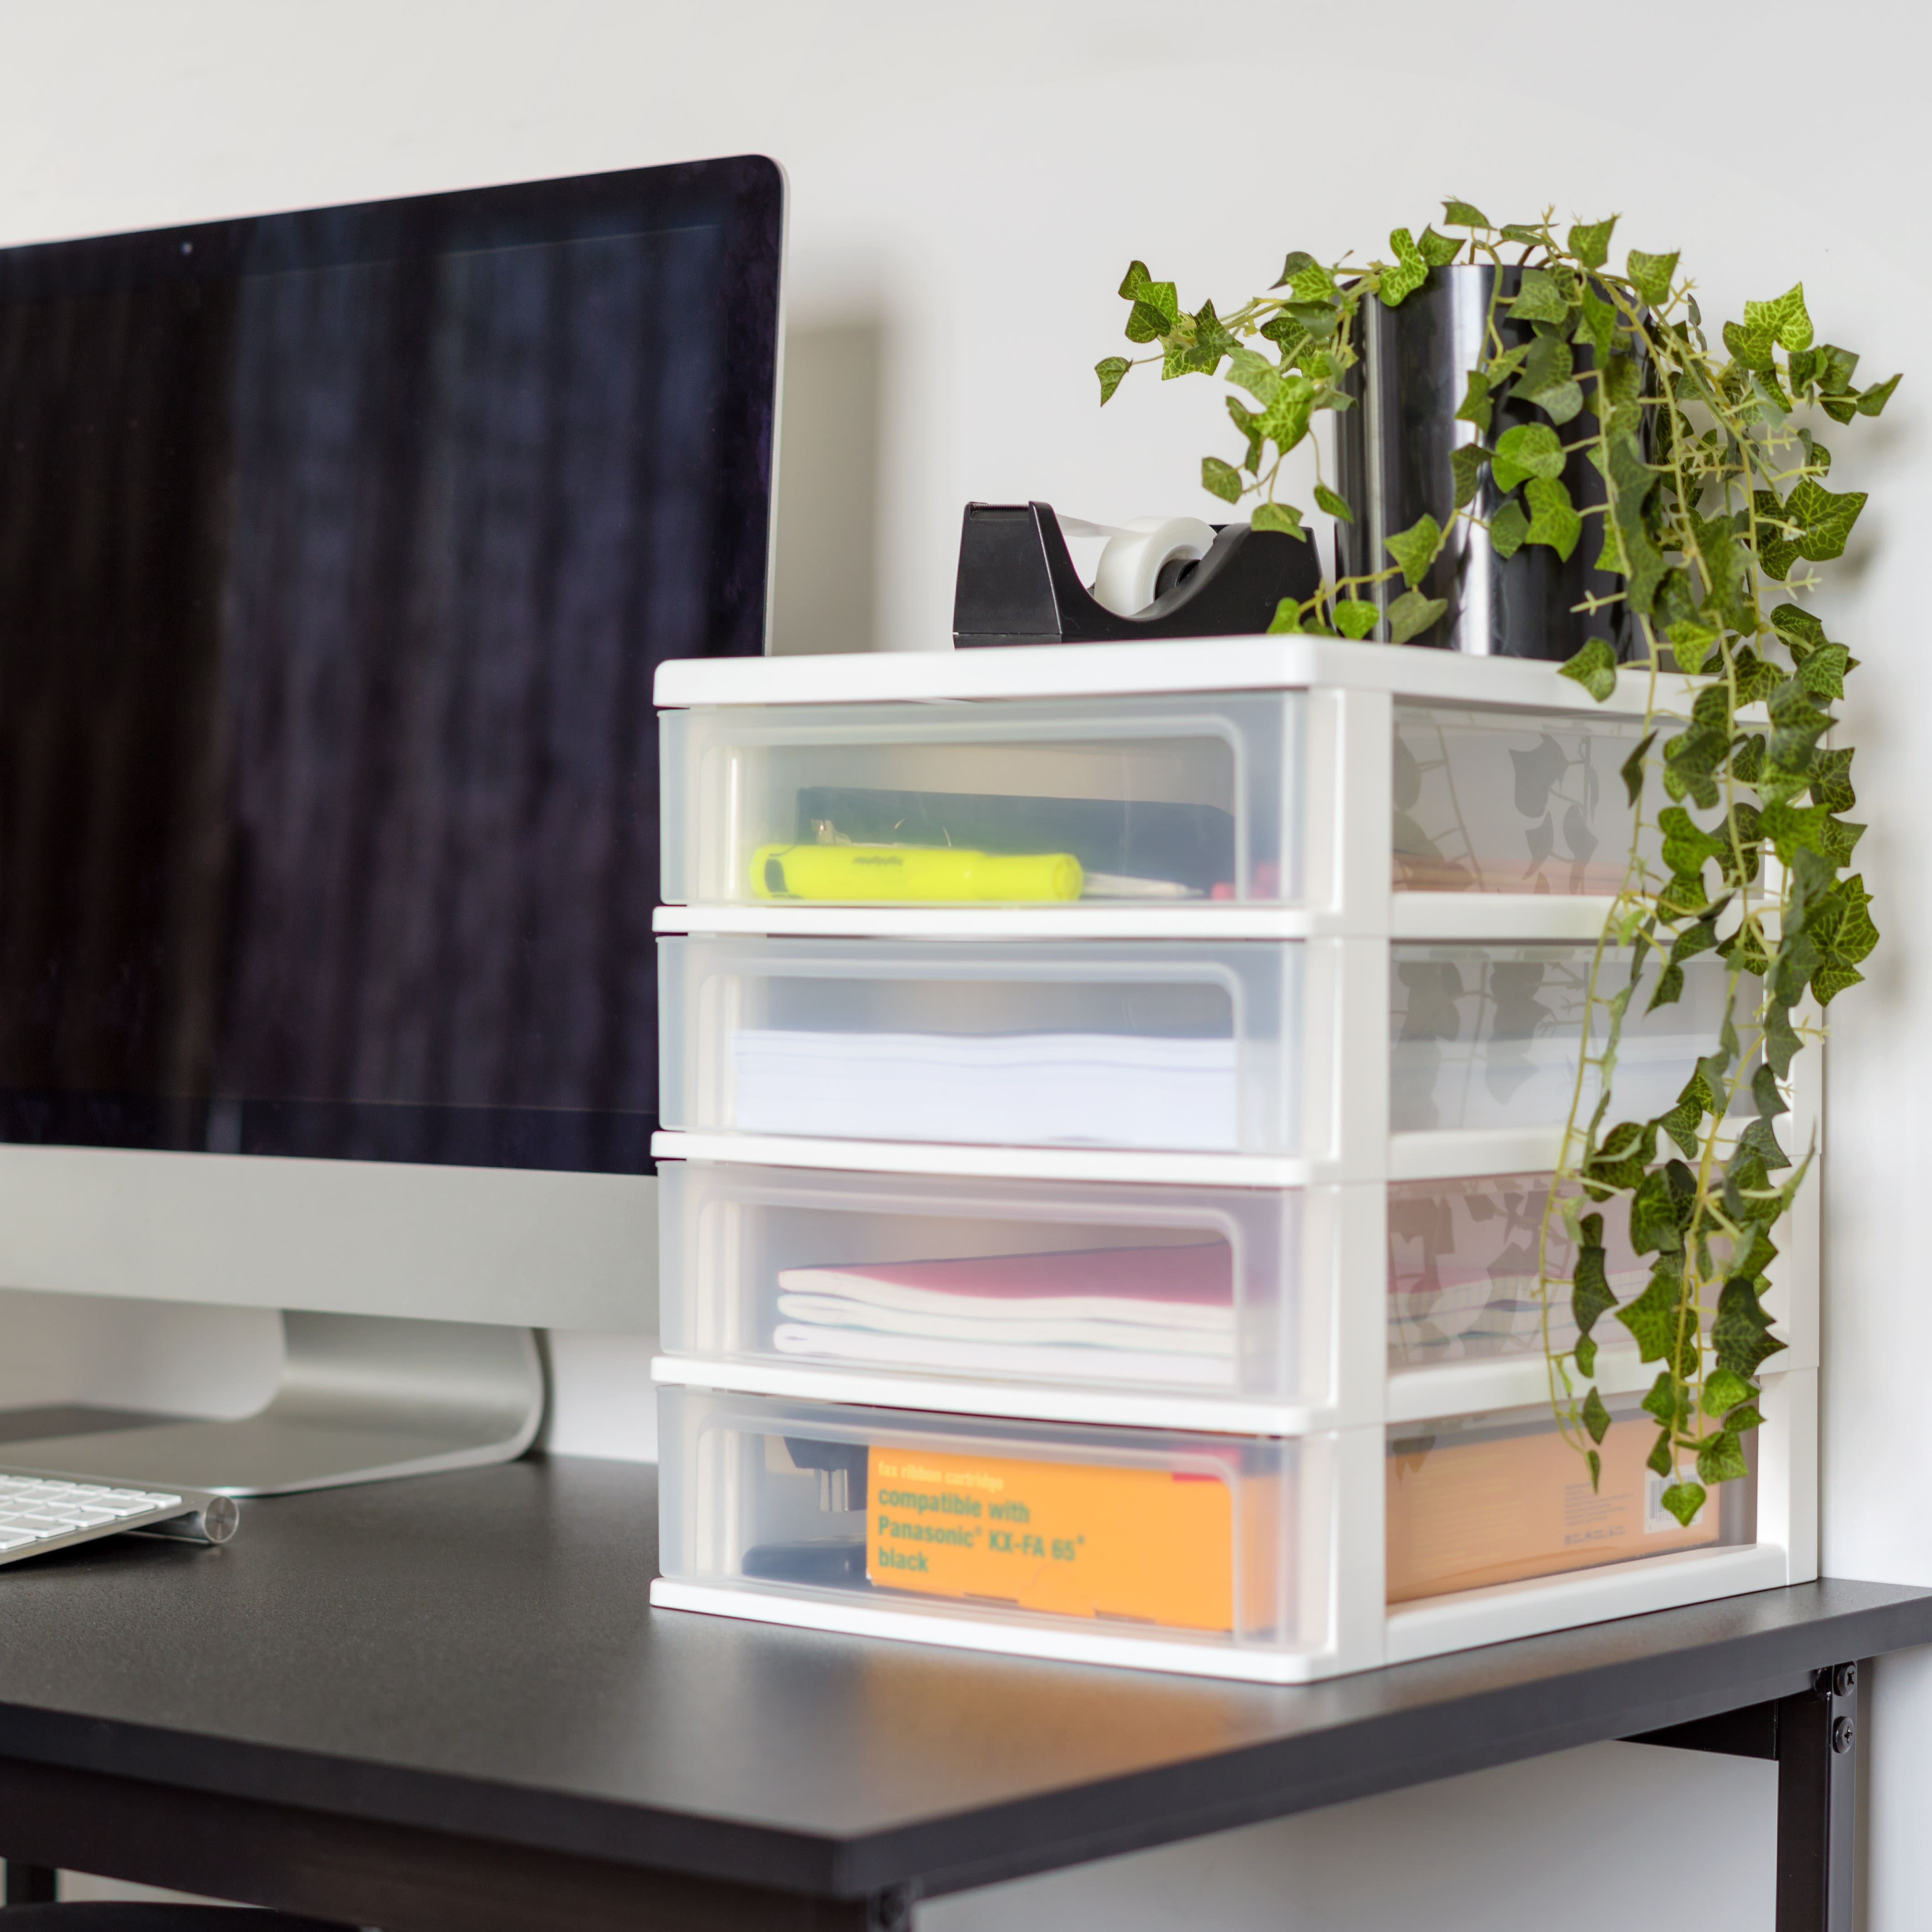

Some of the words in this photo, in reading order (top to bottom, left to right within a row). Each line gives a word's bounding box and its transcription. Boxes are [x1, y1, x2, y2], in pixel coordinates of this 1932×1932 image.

[878, 1461, 898, 1477] fax
[901, 1464, 942, 1483] ribbon
[945, 1471, 1004, 1492] cartridge
[878, 1488, 981, 1517] compatible
[988, 1499, 1030, 1523] with
[989, 1530, 1045, 1557] KX-FA
[878, 1546, 929, 1572] black
